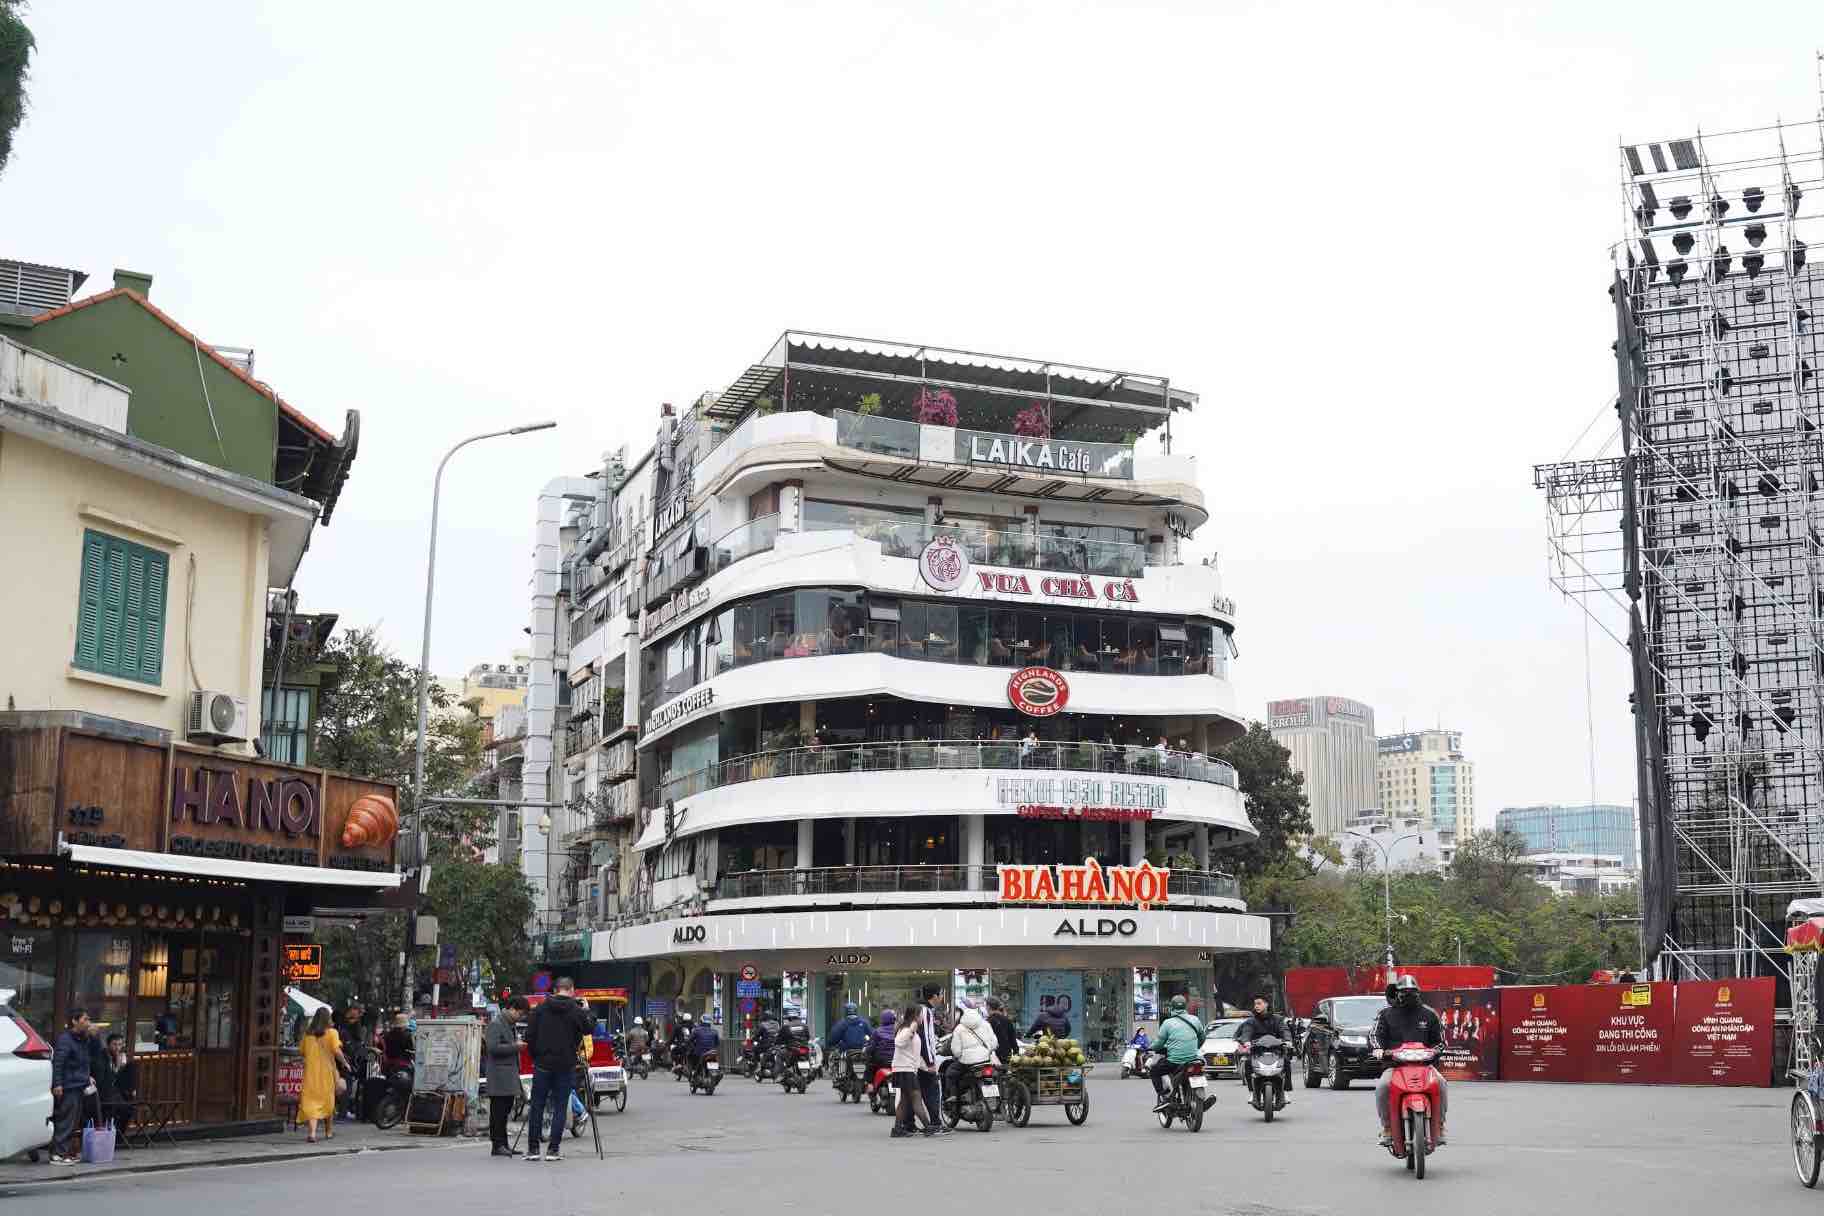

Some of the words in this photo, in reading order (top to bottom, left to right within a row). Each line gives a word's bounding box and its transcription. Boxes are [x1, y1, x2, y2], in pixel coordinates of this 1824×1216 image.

[970, 436, 1054, 468] LAIKA
[1059, 446, 1090, 472] Café
[977, 571, 1032, 595] VUA
[1103, 579, 1139, 602] CÁ
[1012, 669, 1067, 690] HIGHLANDS
[644, 702, 681, 734] HIGHLANDS
[682, 687, 713, 713] COFFEE
[1019, 701, 1060, 715] COFFEE
[1110, 782, 1169, 808] BISTRO
[1000, 867, 1058, 902] BIA
[1060, 858, 1107, 902] HÀ
[1109, 860, 1169, 910] NỘI
[673, 925, 706, 943] ALDO
[1053, 918, 1138, 936] ALDO
[826, 953, 871, 965] ALDO
[1611, 1016, 1627, 1026] KHU
[1628, 1015, 1645, 1028] VỰC
[1599, 1030, 1620, 1039] ĐANG
[1621, 1030, 1634, 1039] THI
[1635, 1026, 1658, 1039] CÔNG
